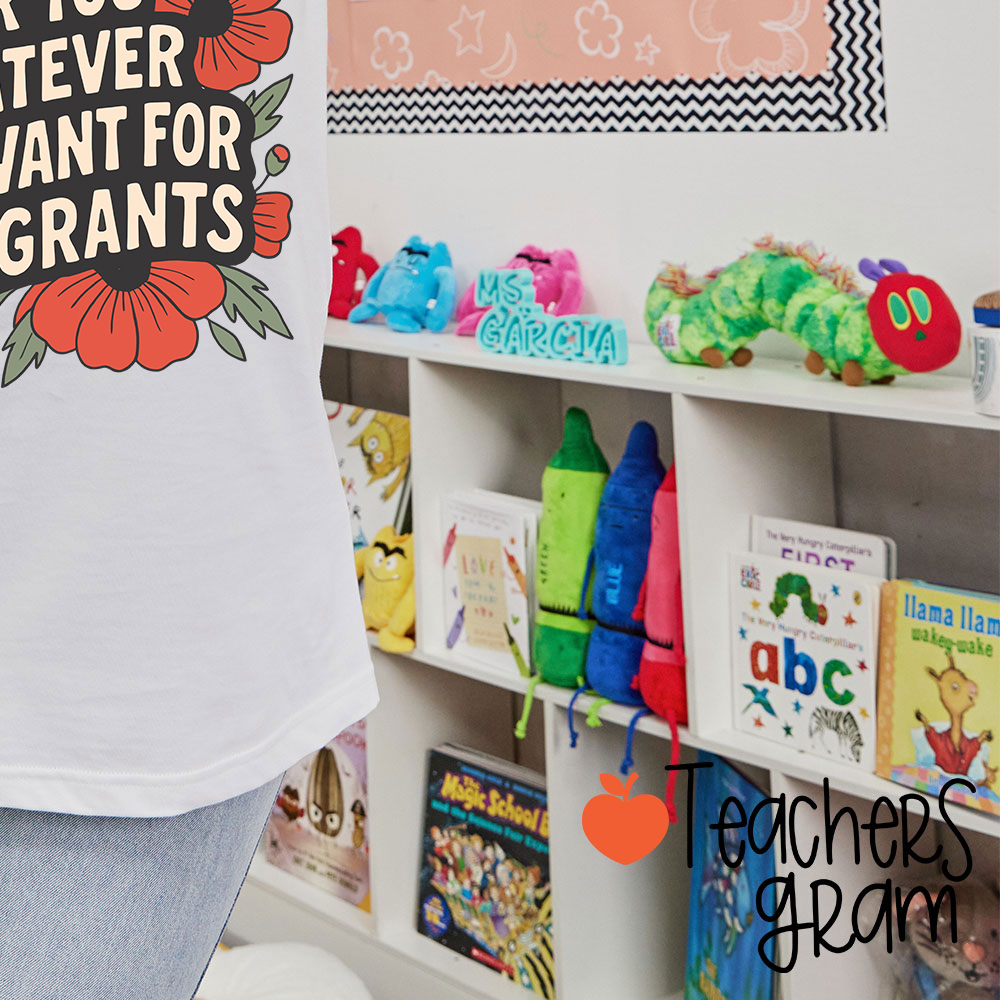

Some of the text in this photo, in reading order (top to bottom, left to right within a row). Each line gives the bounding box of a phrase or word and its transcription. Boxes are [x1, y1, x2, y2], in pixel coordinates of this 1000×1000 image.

[142, 101, 241, 171] FOR
[477, 308, 622, 364] GARCIA
[462, 554, 495, 576] LOVE
[798, 536, 823, 549] Hungry
[605, 560, 623, 605] BLUE
[904, 593, 1000, 637] llama llam
[911, 627, 993, 658] wakey-wake
[750, 636, 855, 706] abc
[441, 772, 487, 811] Magic
[487, 788, 540, 832] School
